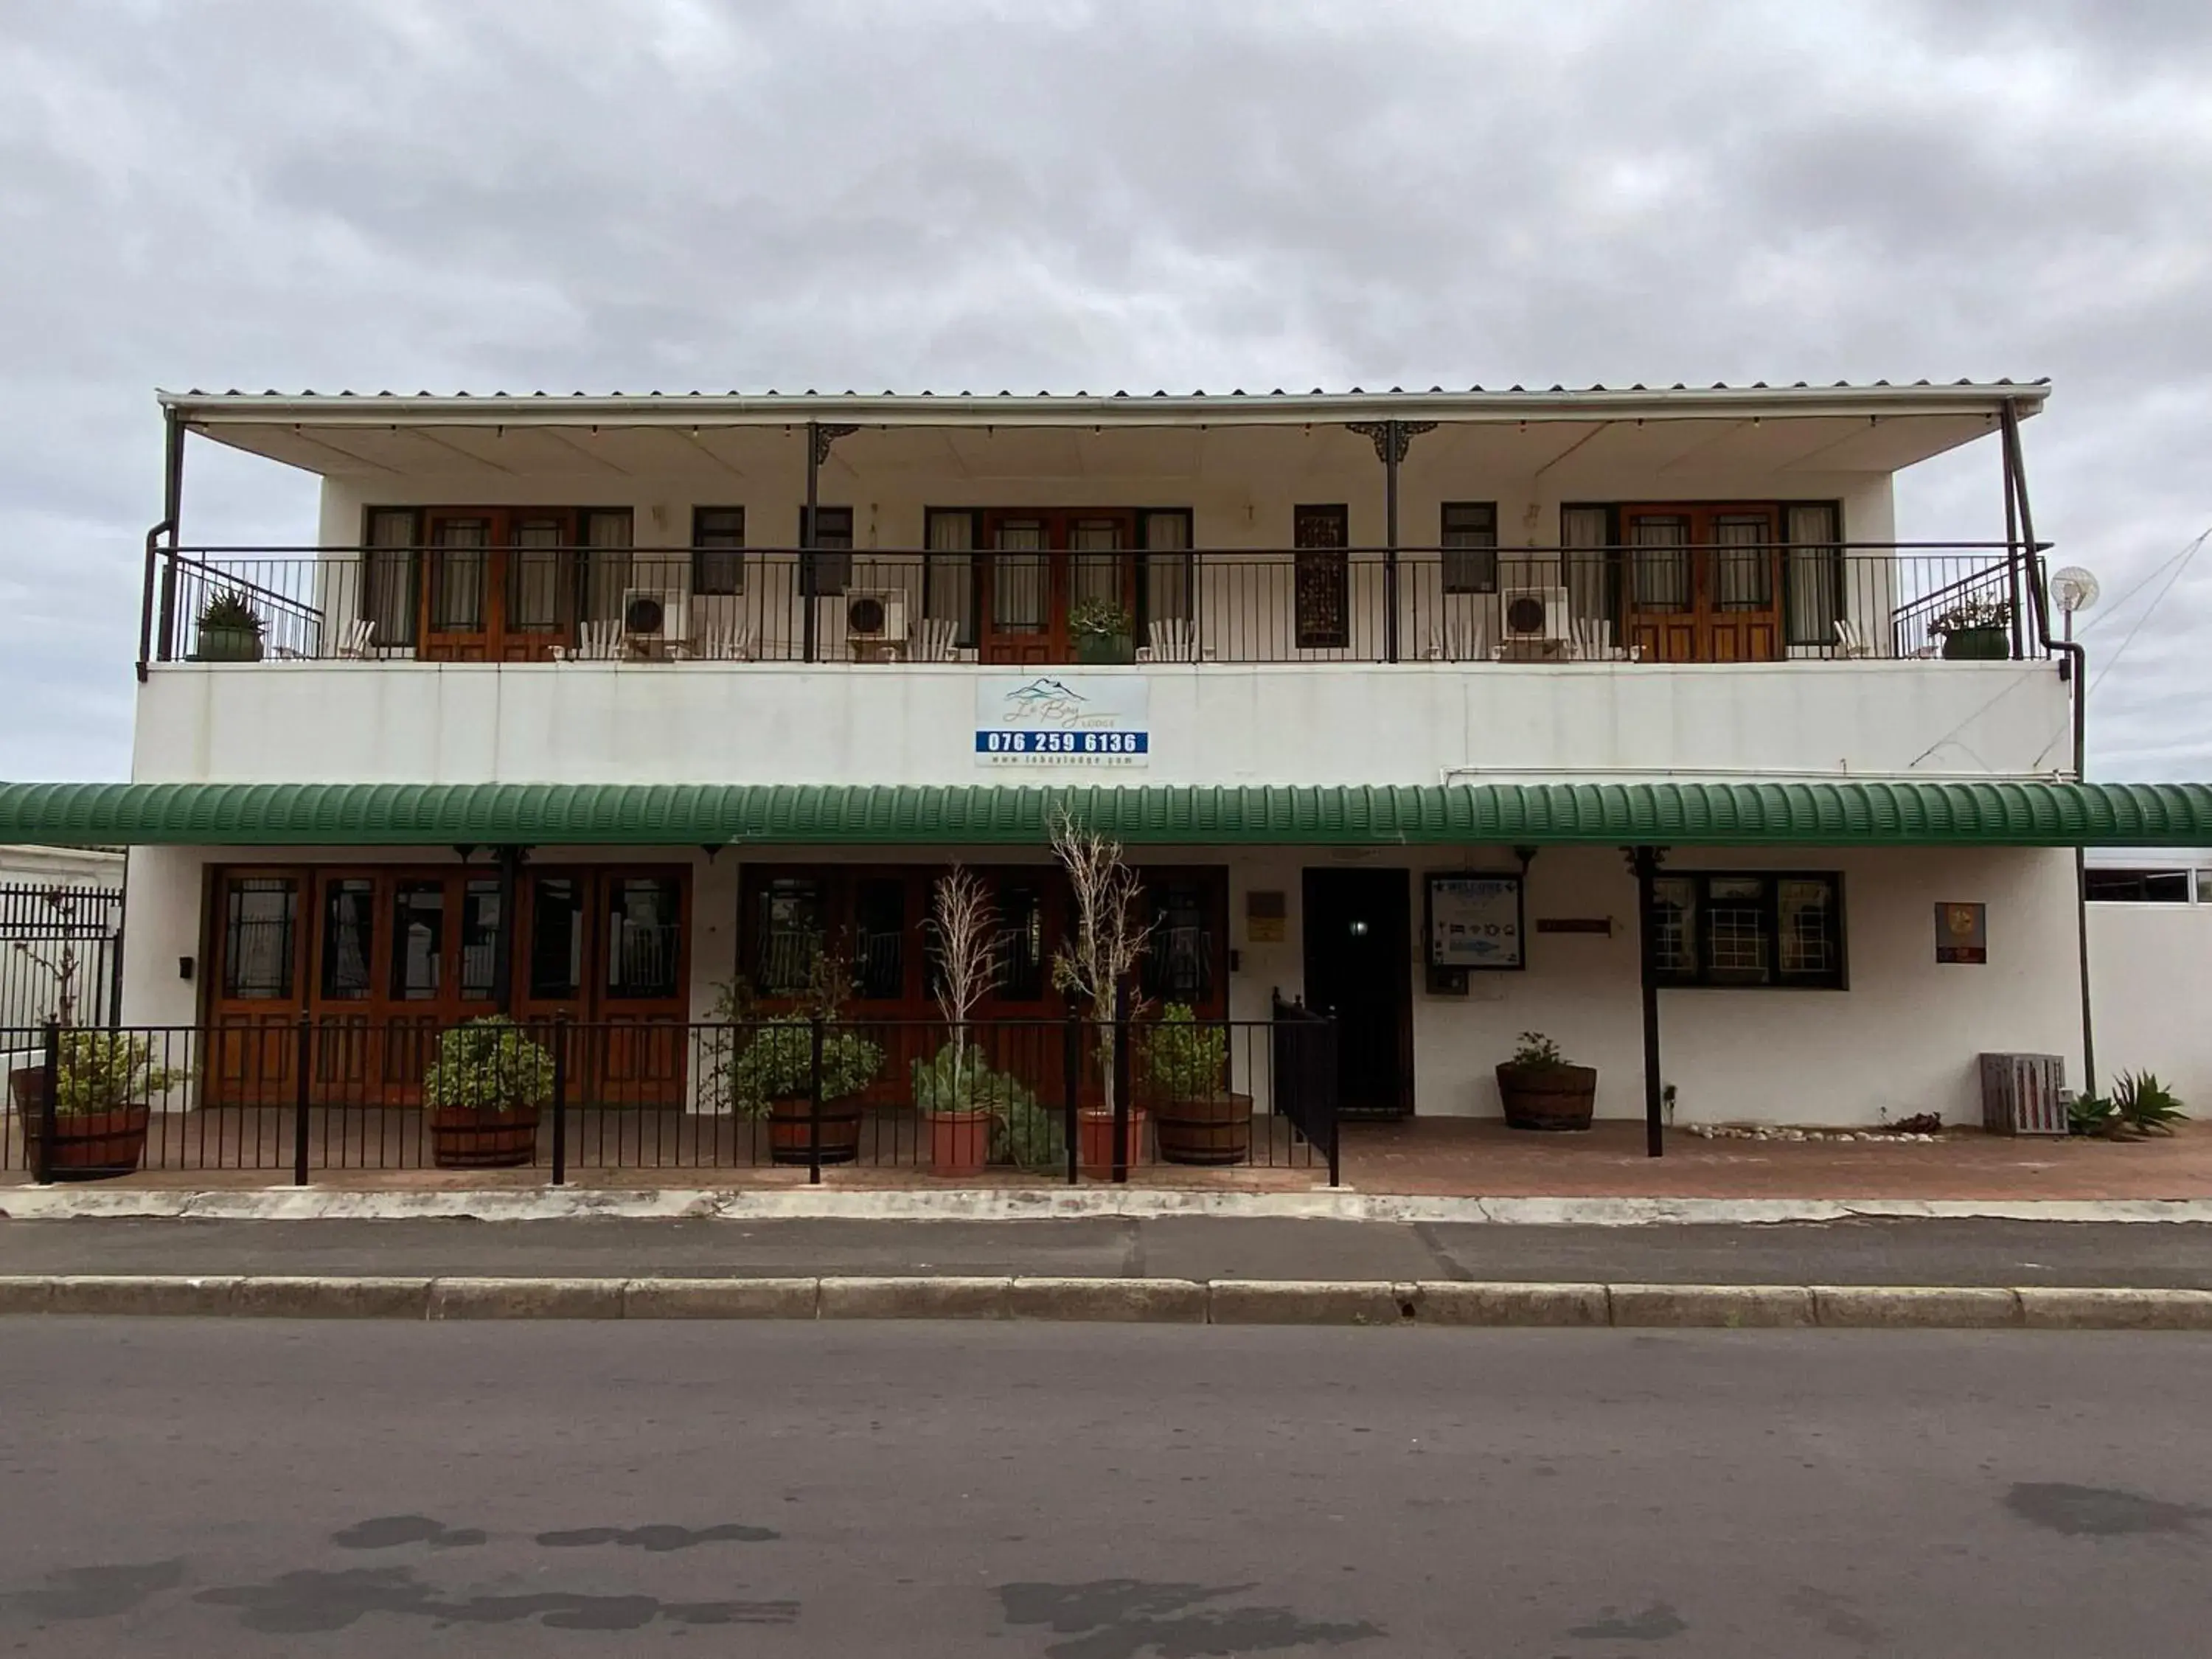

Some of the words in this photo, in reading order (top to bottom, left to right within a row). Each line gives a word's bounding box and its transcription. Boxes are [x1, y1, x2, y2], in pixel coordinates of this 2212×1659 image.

[1040, 700, 1121, 728] Bay
[989, 734, 1026, 751] 076
[1035, 734, 1075, 751] 259
[1085, 734, 1136, 752] 6136
